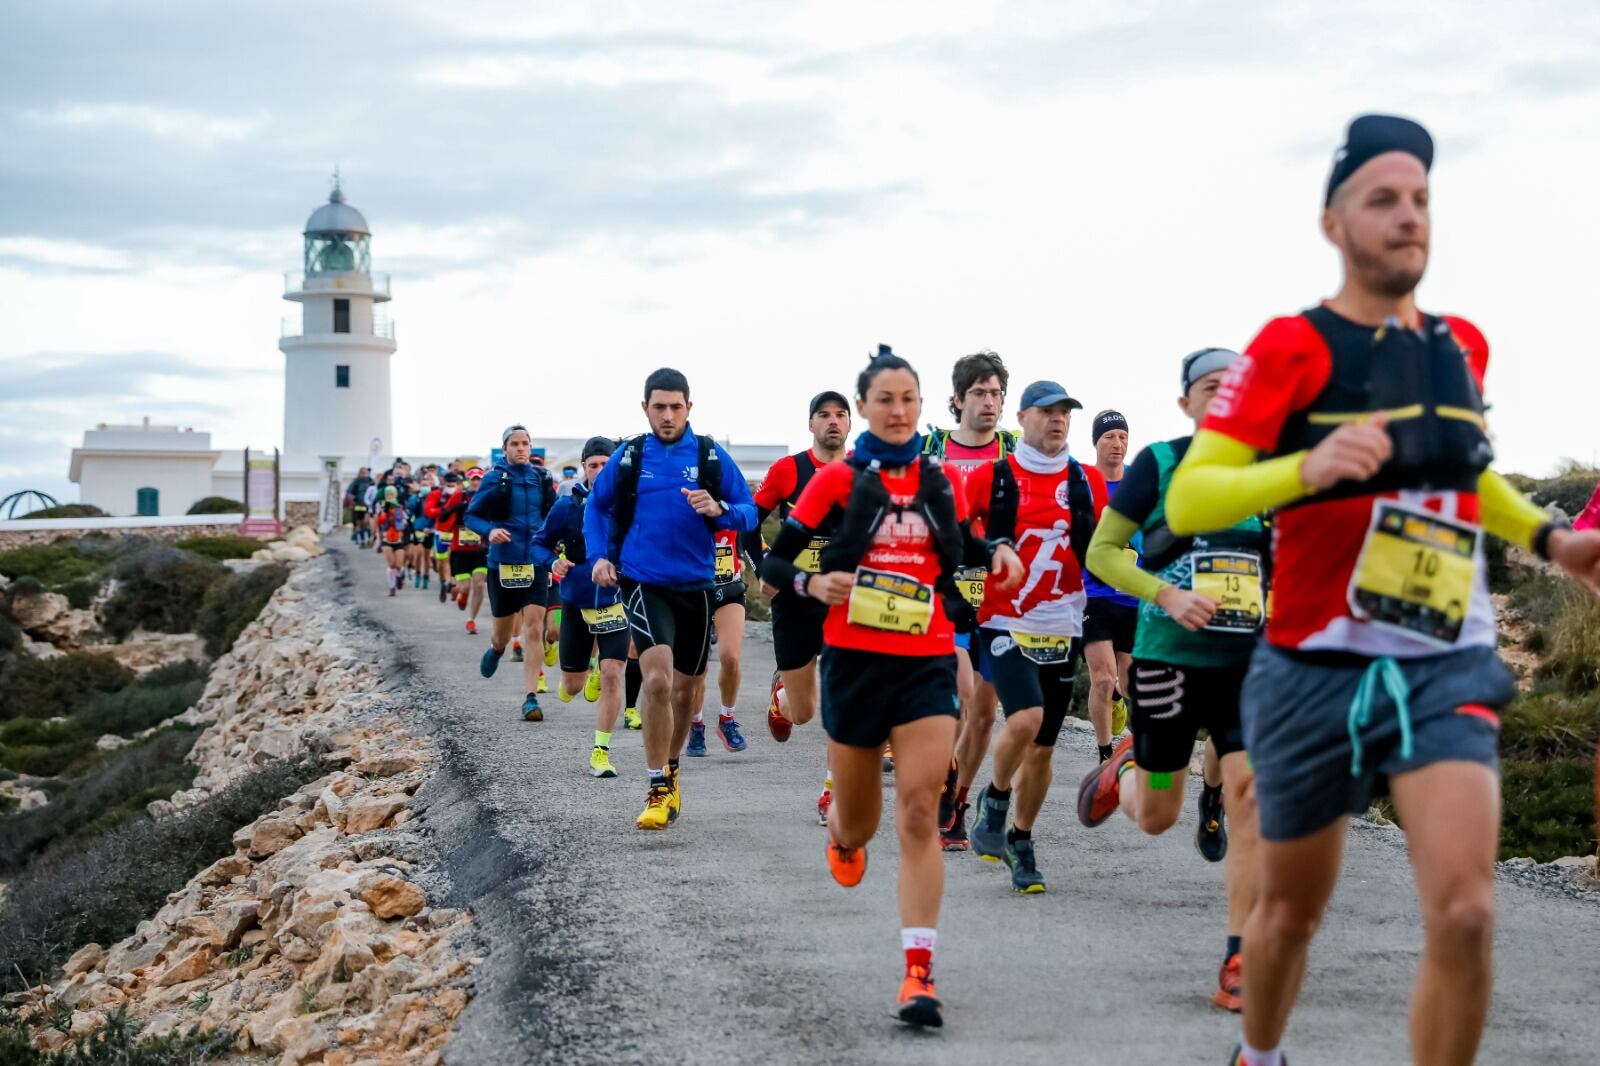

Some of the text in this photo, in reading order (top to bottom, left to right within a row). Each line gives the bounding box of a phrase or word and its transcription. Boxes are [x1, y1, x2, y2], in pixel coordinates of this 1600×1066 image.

[1413, 549, 1440, 578] 10
[970, 582, 983, 595] 69
[1224, 575, 1240, 592] 13
